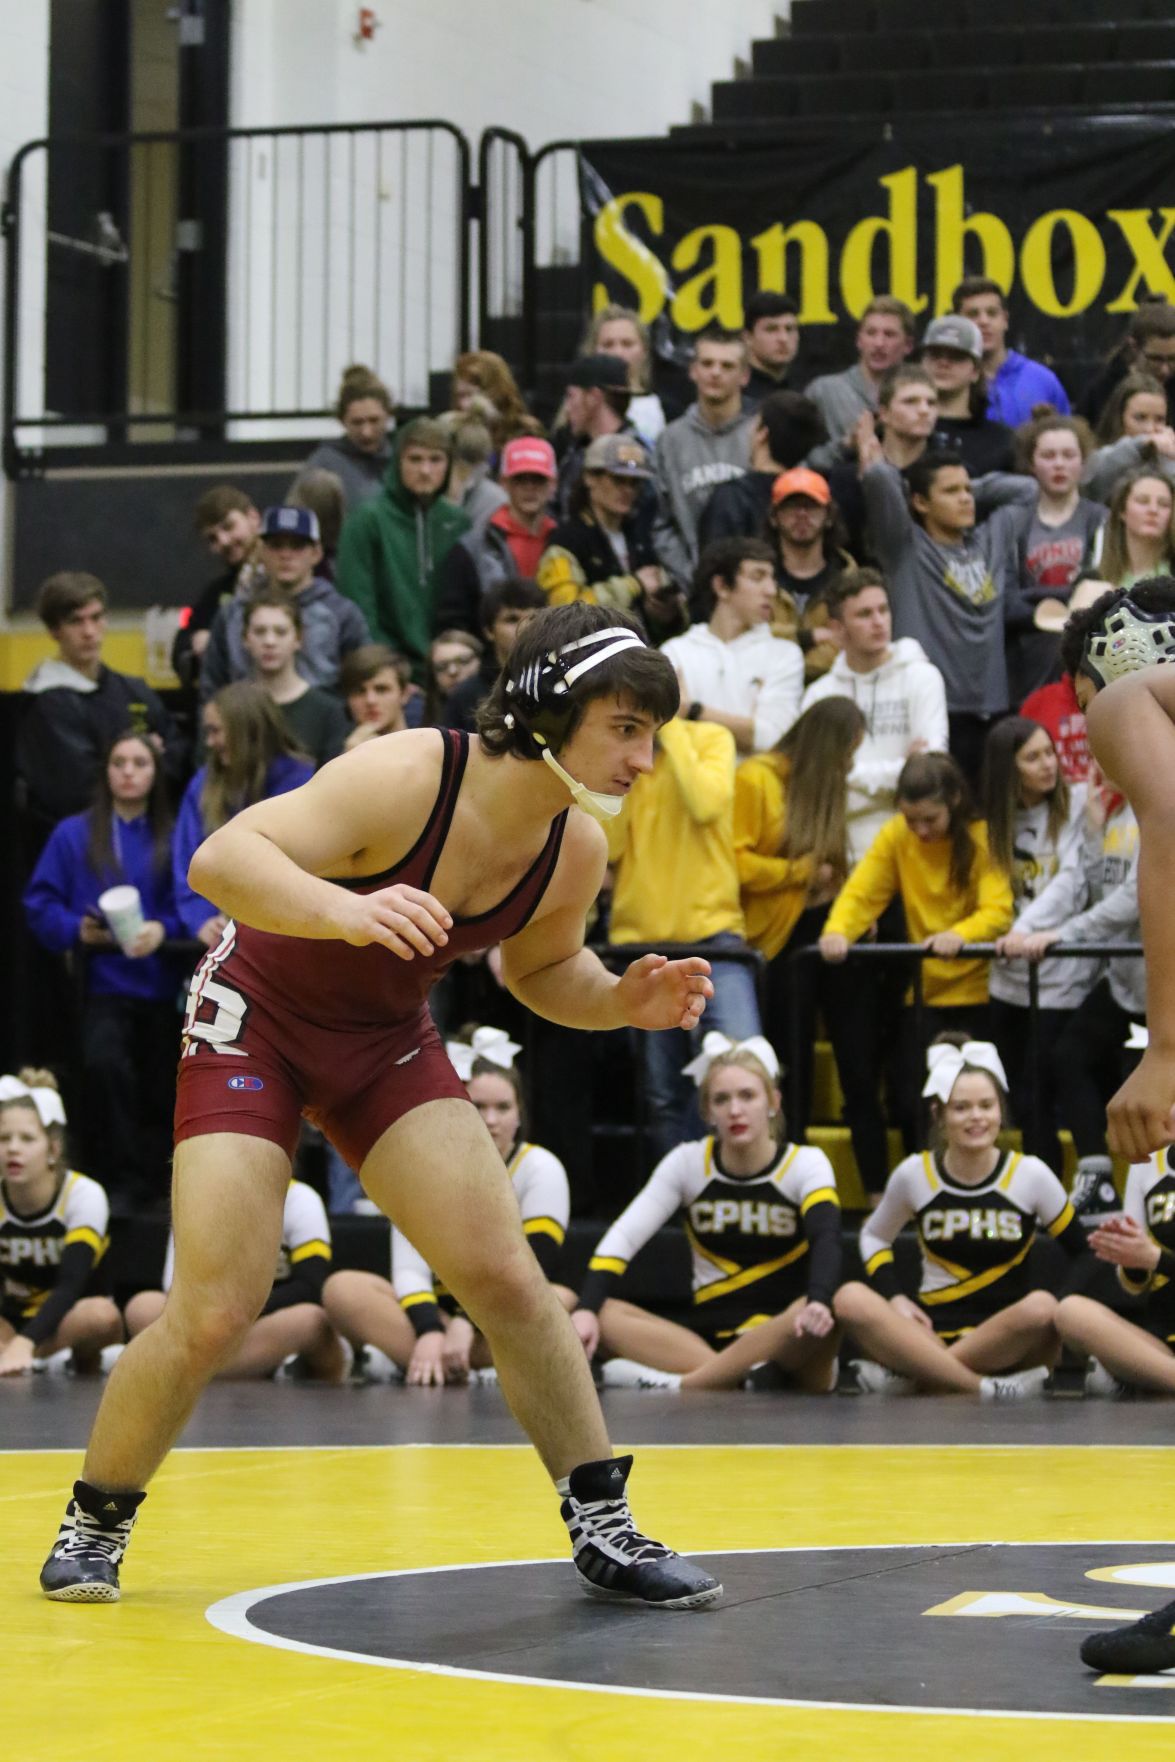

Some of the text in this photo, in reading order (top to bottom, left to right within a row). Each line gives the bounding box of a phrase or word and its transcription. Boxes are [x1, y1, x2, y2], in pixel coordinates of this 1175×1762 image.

[592, 163, 1175, 333] Sandbox
[689, 1199, 797, 1236] CPHS
[922, 1208, 1023, 1241] CPHS
[0, 1237, 64, 1266] PH
